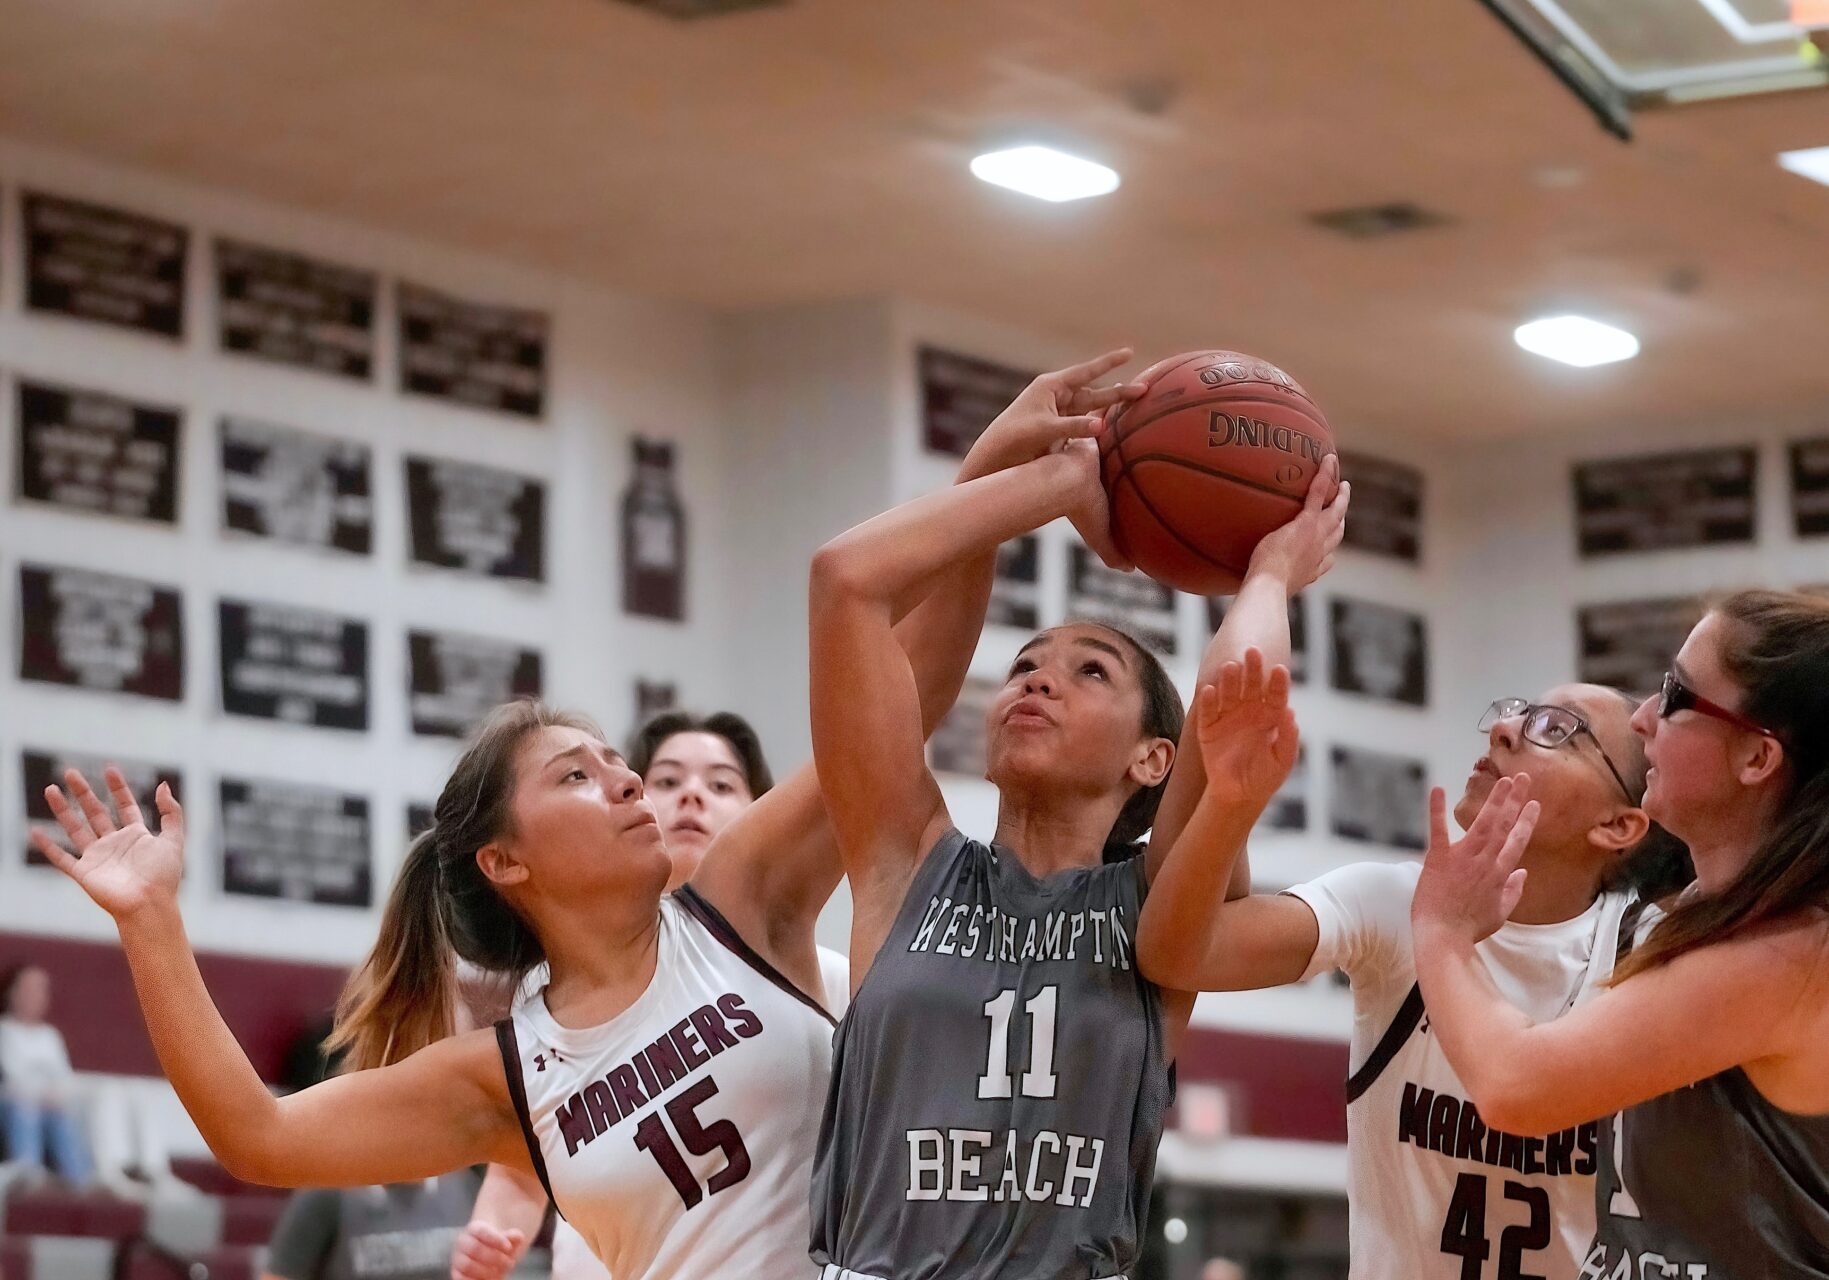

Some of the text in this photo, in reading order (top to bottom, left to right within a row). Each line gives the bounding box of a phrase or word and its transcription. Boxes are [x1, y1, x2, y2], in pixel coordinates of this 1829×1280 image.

[555, 992, 764, 1158] MARINERS
[977, 985, 1057, 1100] 11
[632, 1074, 752, 1211] 15
[905, 1128, 1106, 1208] BEACH
